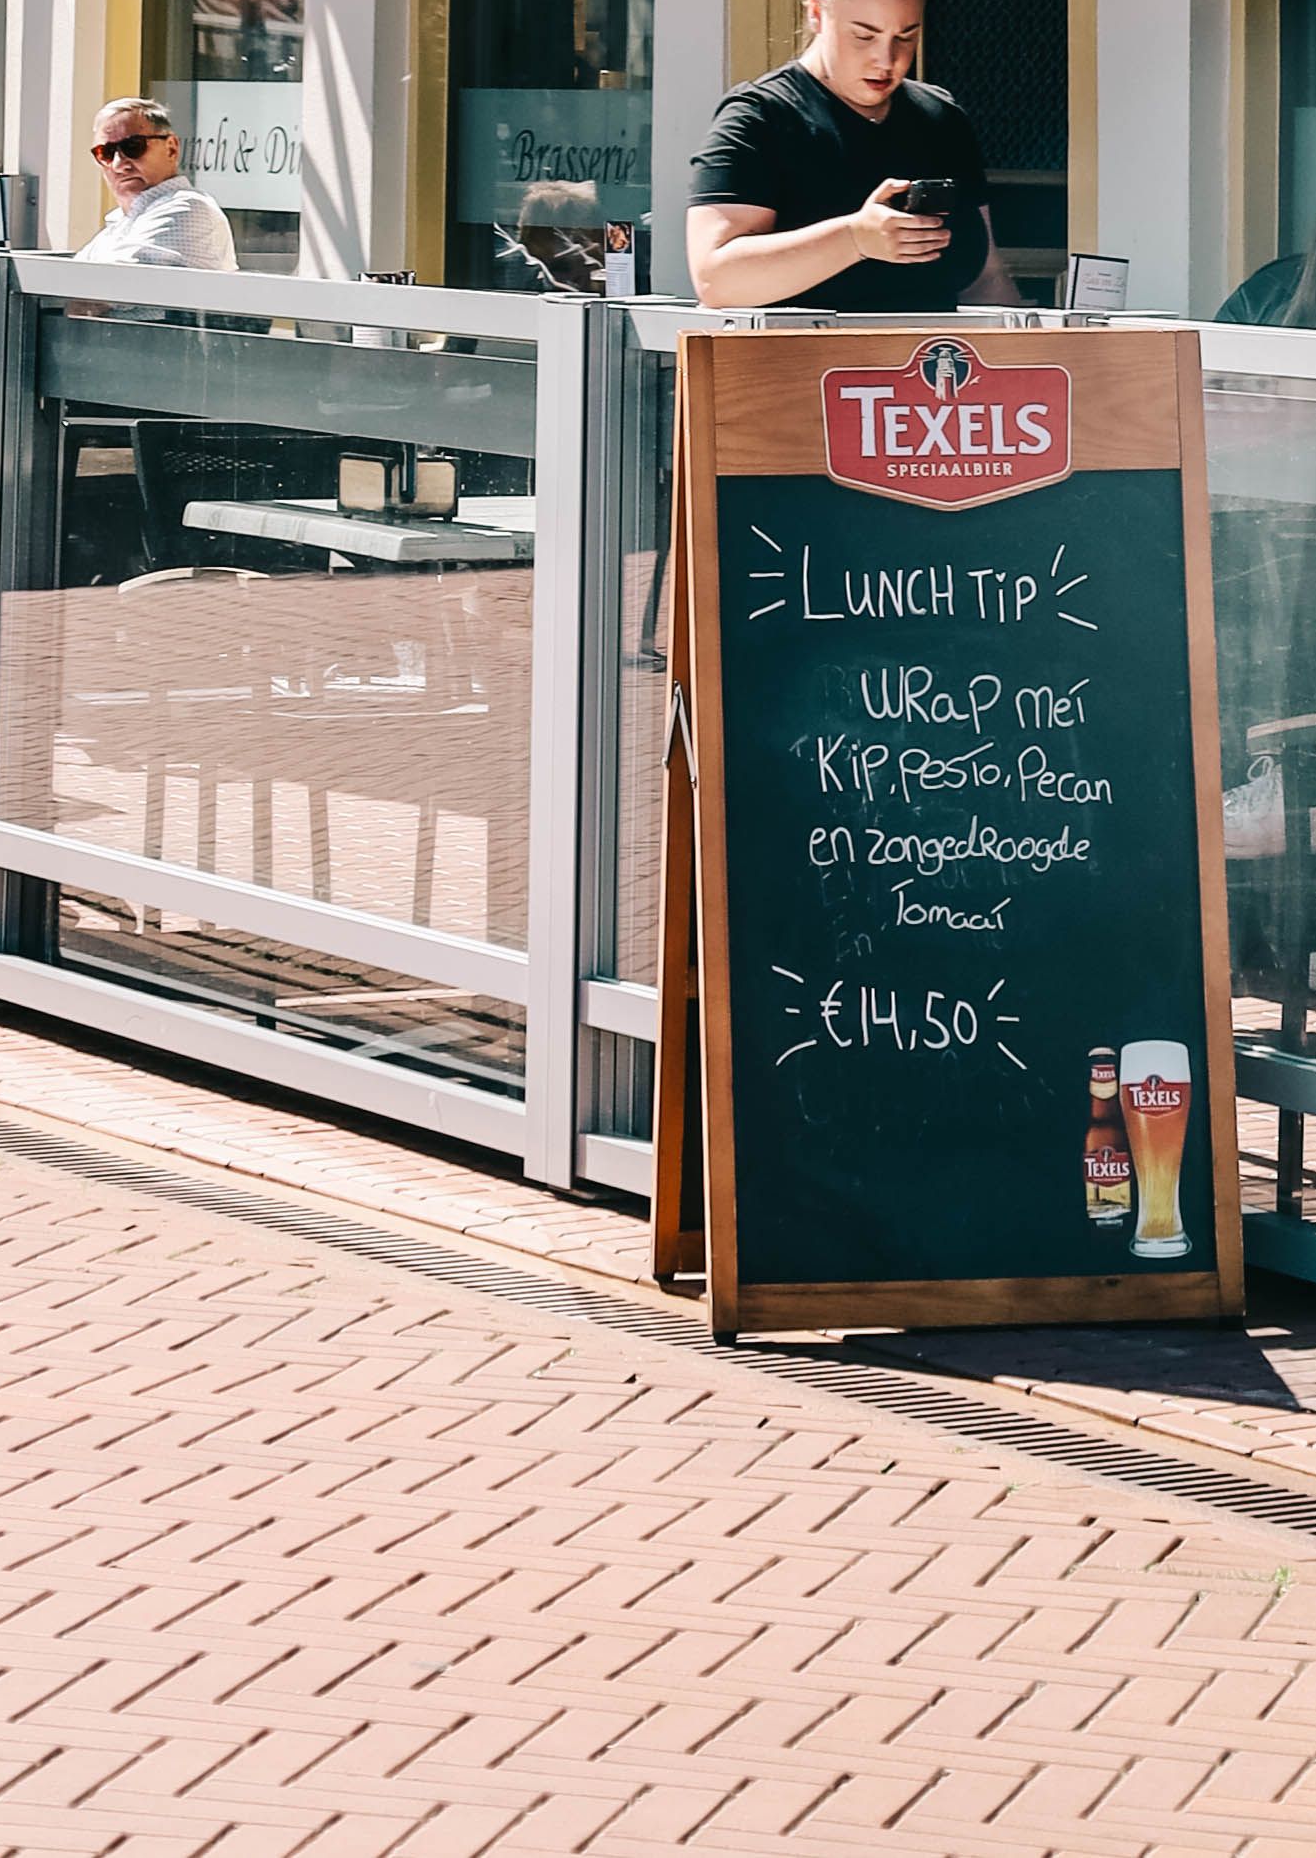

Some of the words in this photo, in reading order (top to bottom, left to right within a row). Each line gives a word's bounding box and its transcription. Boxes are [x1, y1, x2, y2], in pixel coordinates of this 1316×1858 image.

[234, 129, 258, 173] &
[512, 129, 637, 185] Brasserie
[887, 461, 1013, 478] SPECIAALBIER
[809, 826, 855, 866] en
[820, 980, 979, 1050] €14,50
